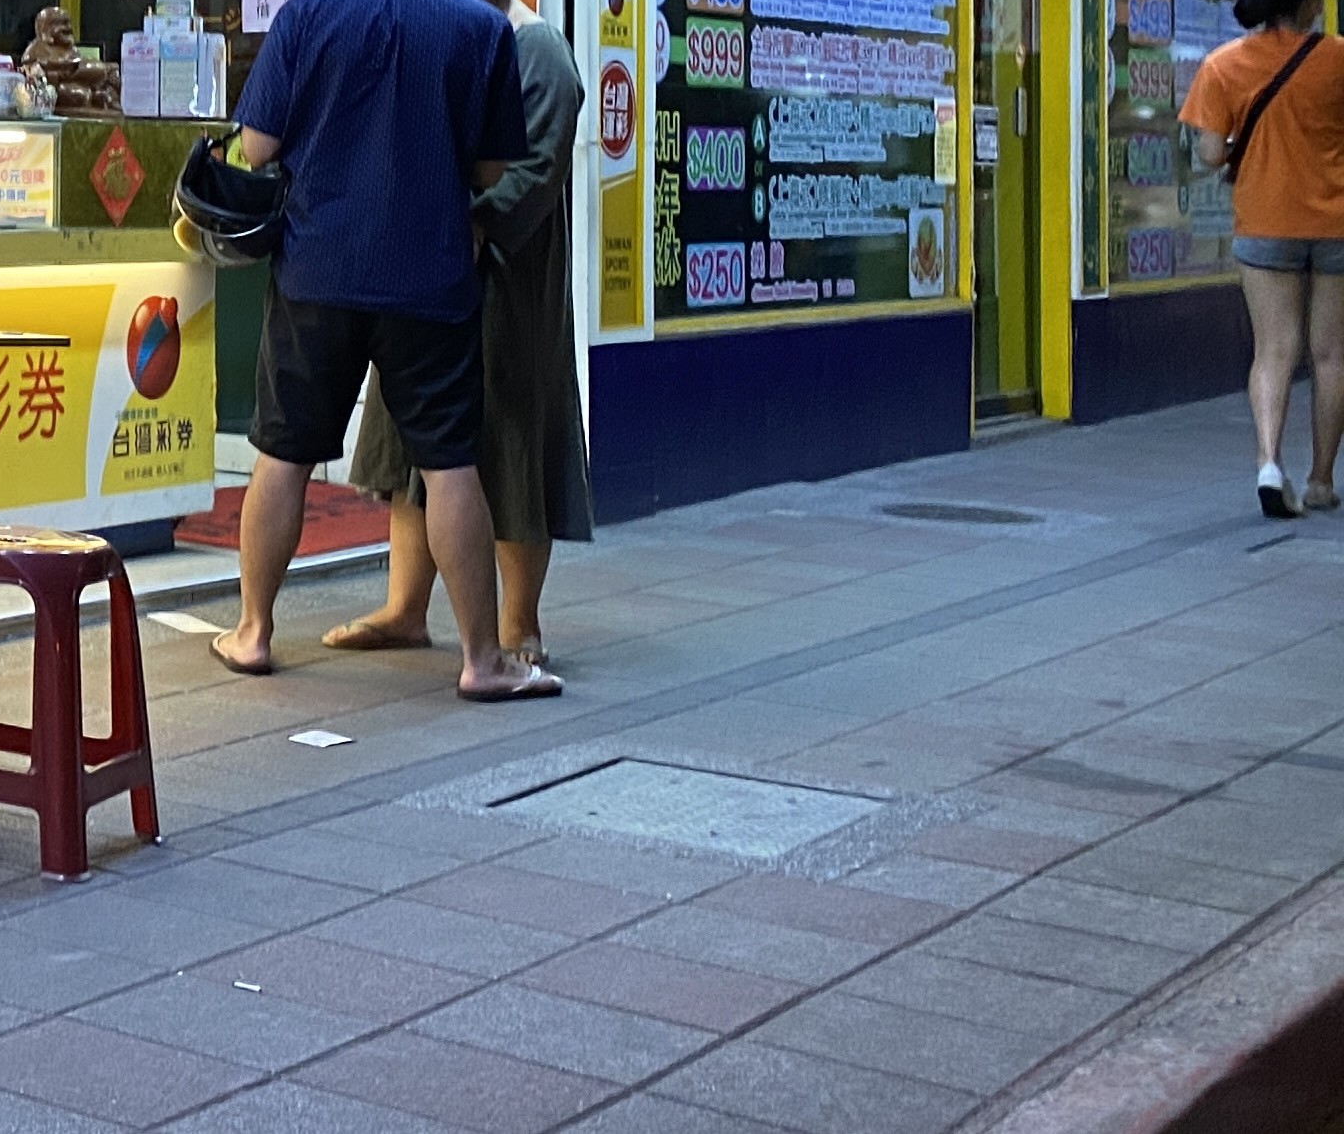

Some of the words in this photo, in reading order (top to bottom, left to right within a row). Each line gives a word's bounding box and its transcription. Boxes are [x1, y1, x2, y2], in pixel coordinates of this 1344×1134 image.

[688, 28, 743, 81] $999
[688, 133, 743, 184] $400
[688, 246, 743, 301] $250
